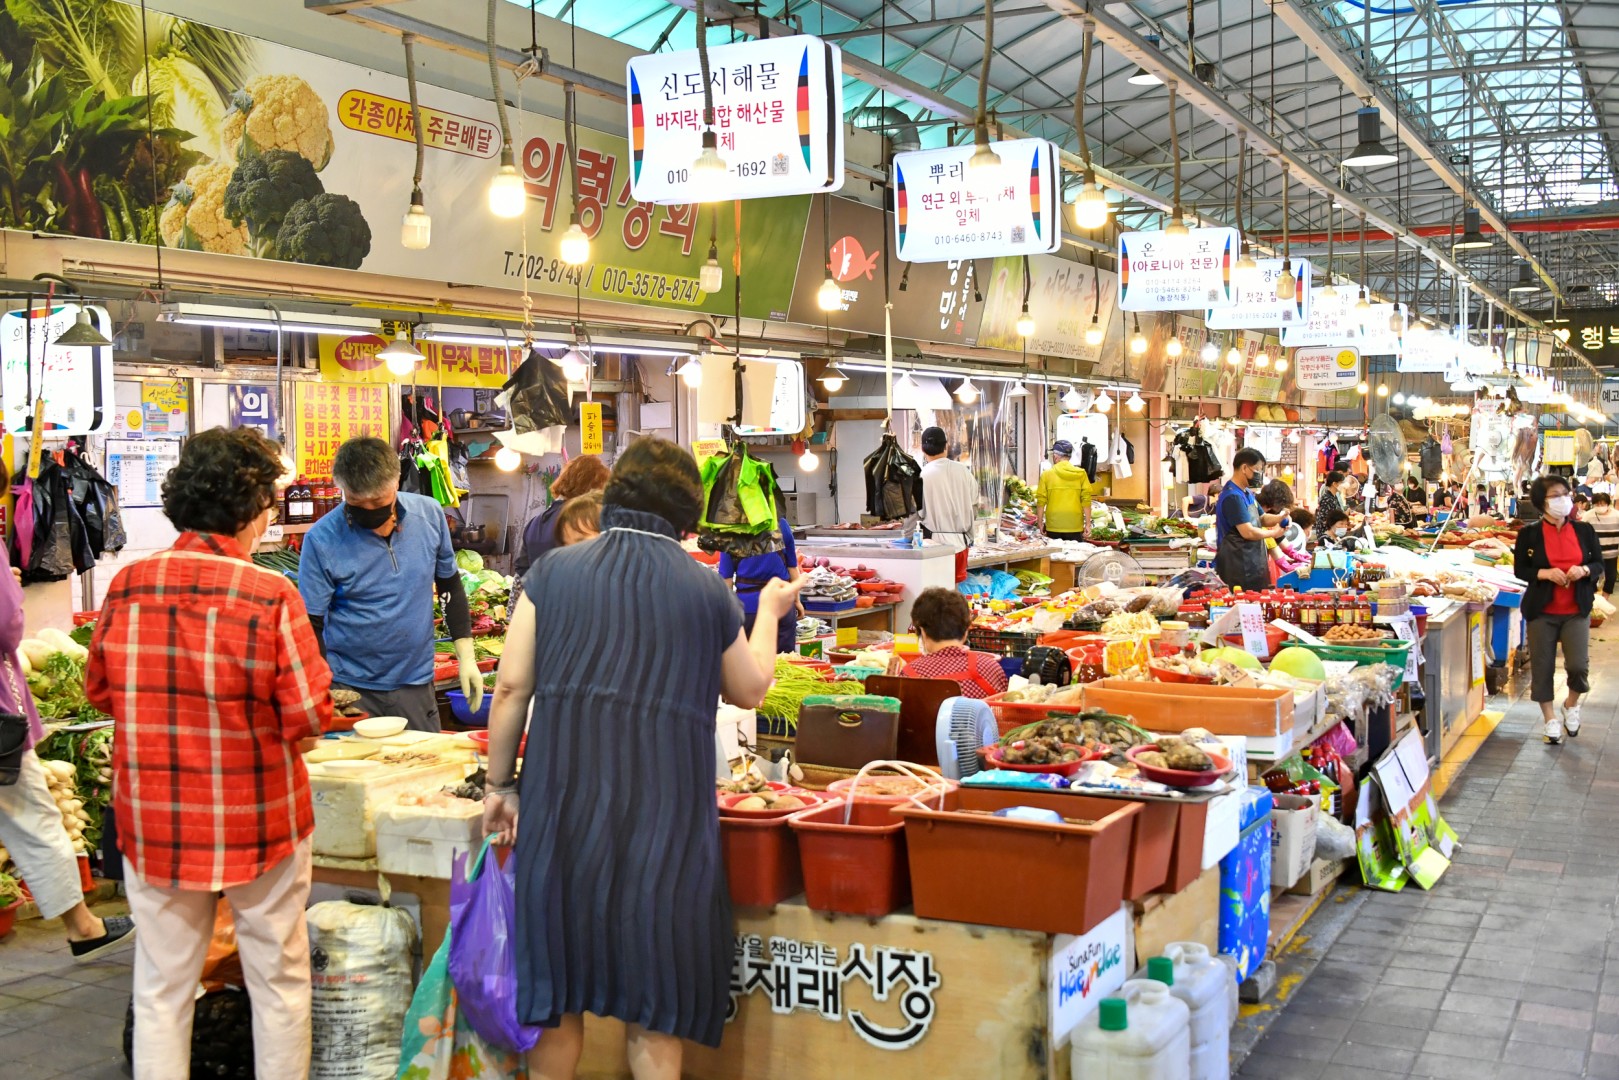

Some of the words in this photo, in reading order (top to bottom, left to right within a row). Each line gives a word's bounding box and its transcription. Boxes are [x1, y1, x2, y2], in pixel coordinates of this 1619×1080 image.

[660, 62, 780, 101] 신도시해물
[736, 100, 785, 124] 해산물
[427, 115, 493, 154] 주문배달
[922, 192, 945, 210] 연근
[949, 190, 961, 205] 외
[955, 208, 980, 226] 일체
[1132, 259, 1184, 272] (아로니아
[1190, 257, 1219, 270] 전문)
[602, 267, 700, 303] 010-3578-8747
[347, 386, 382, 403] 멸치젓
[304, 402, 340, 420] 창란젓
[348, 405, 382, 421] 조개젓
[304, 421, 341, 438] 명란젓
[771, 940, 838, 966] 책임지는
[1058, 941, 1121, 1008] Haeundae
